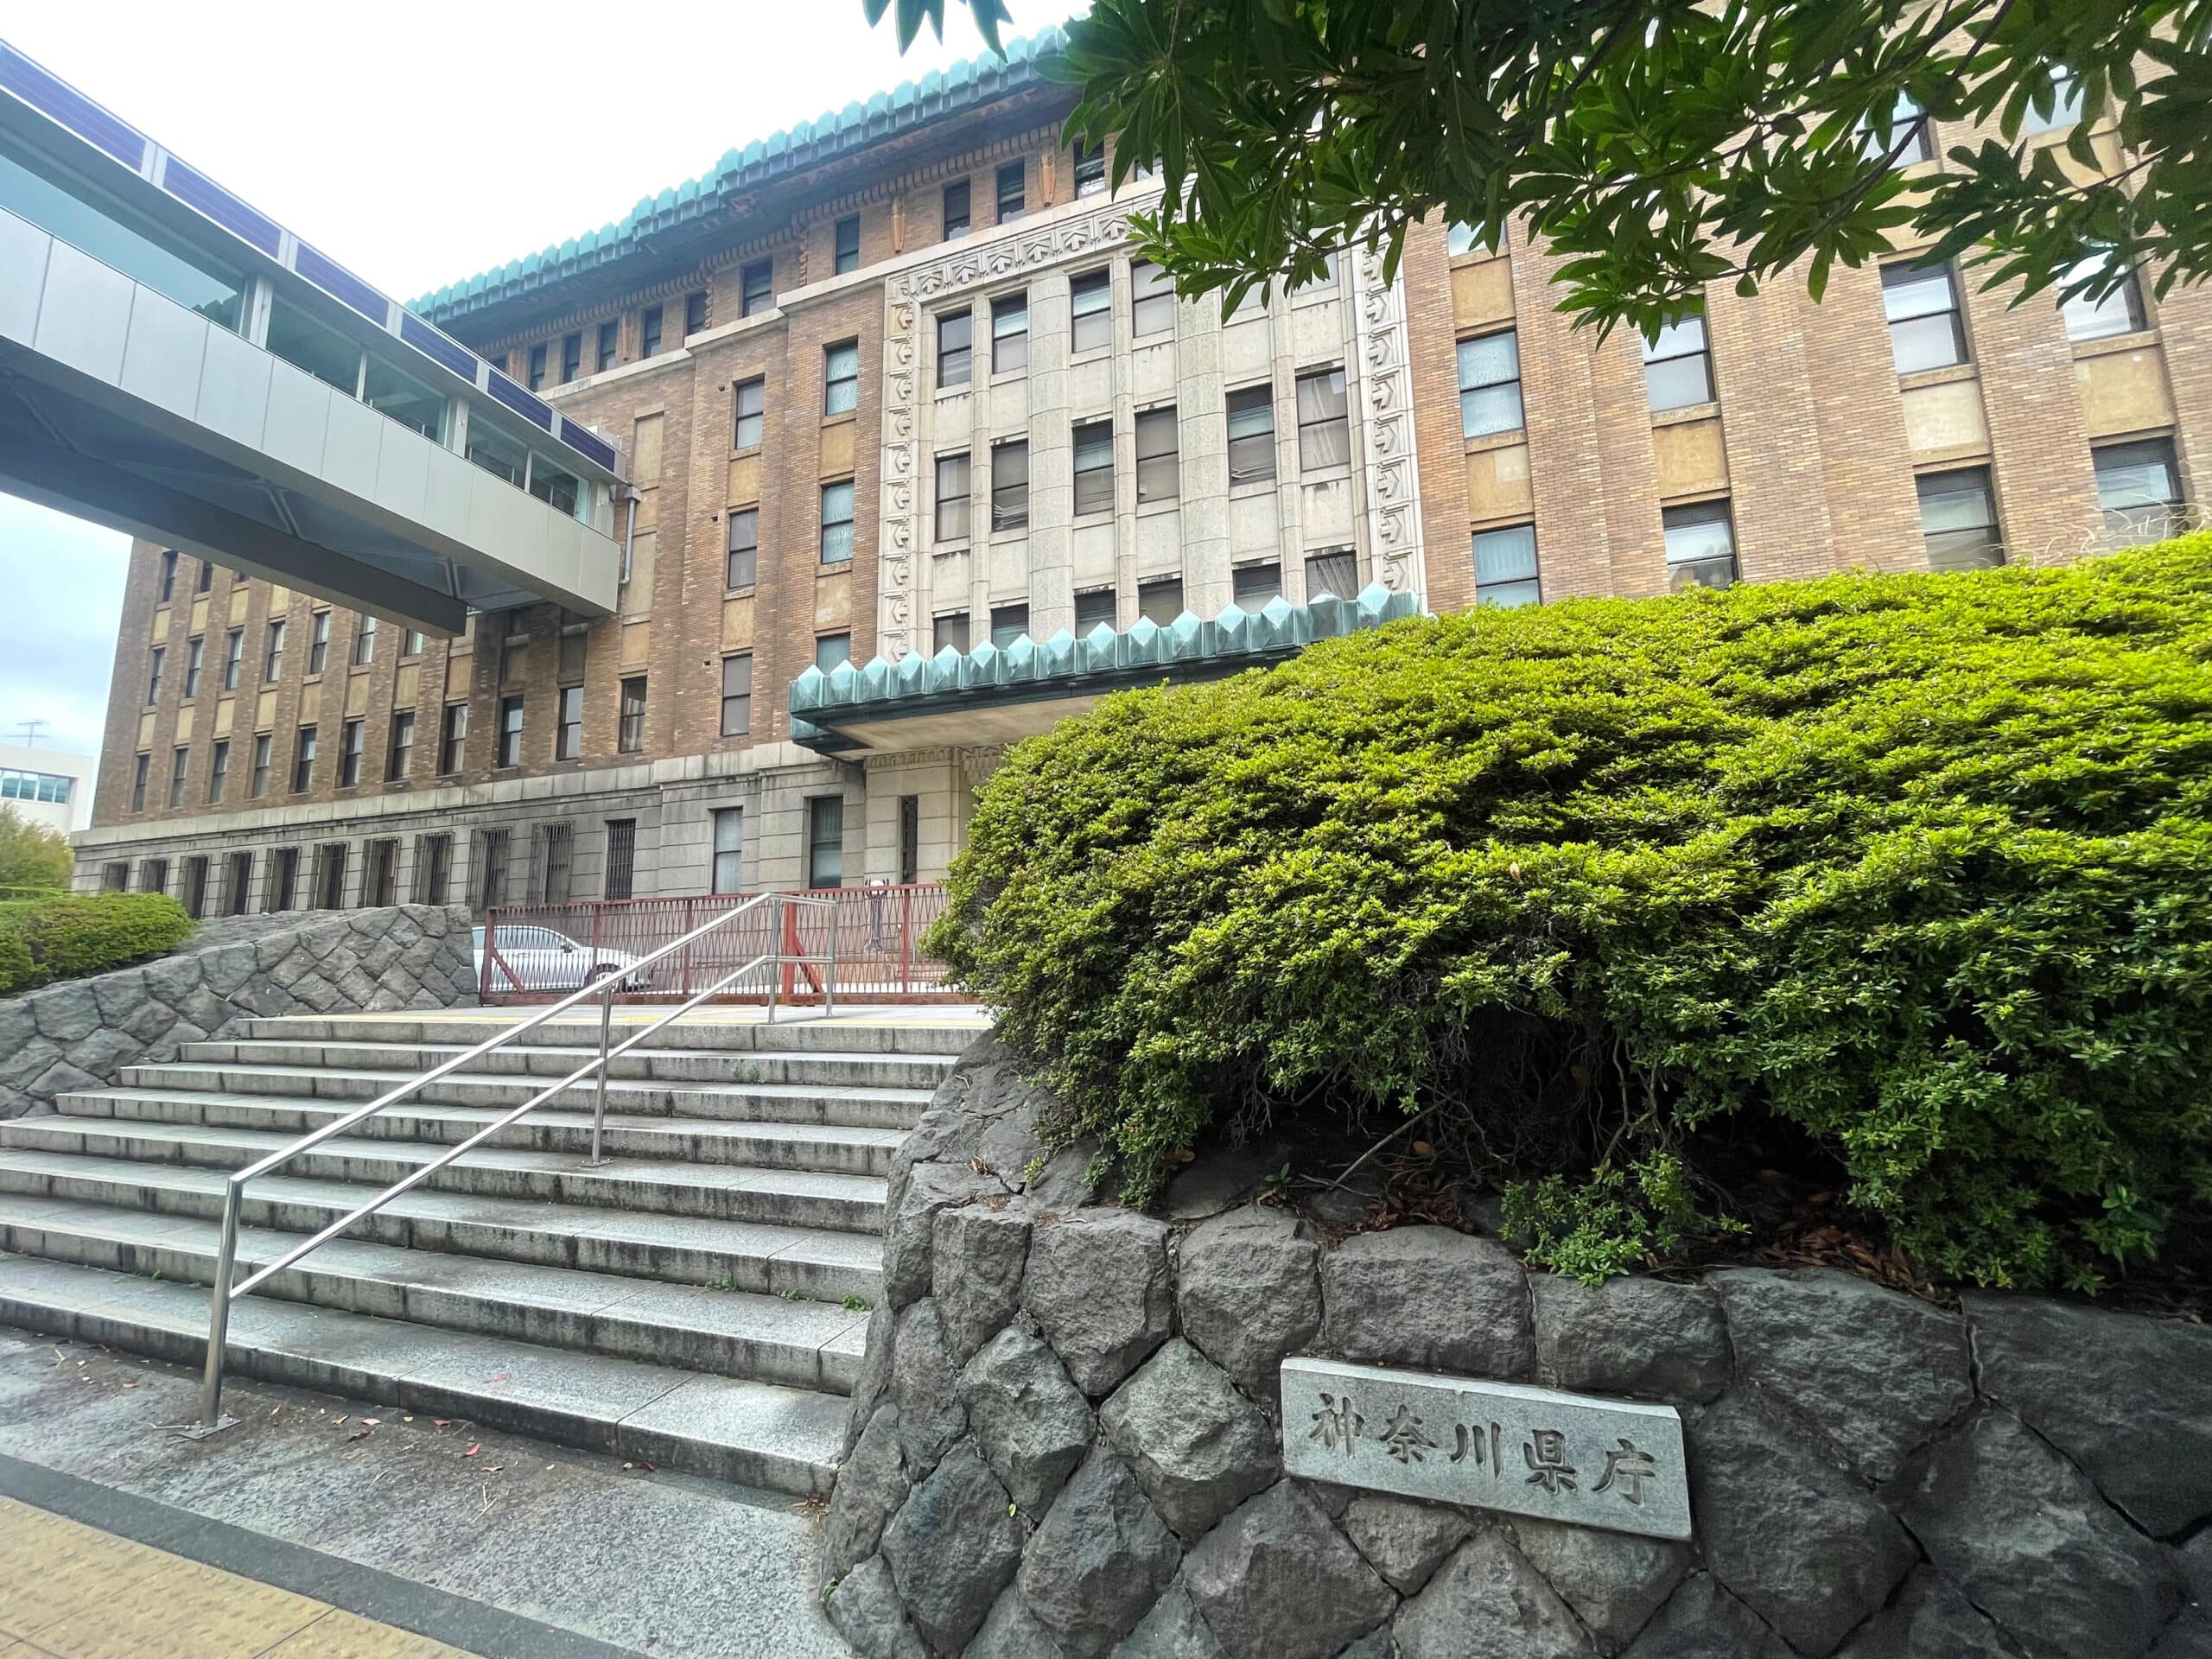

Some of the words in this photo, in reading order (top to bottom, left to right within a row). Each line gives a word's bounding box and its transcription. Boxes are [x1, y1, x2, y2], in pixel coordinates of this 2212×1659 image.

[1308, 1392, 1656, 1507] 神奈川県庁
